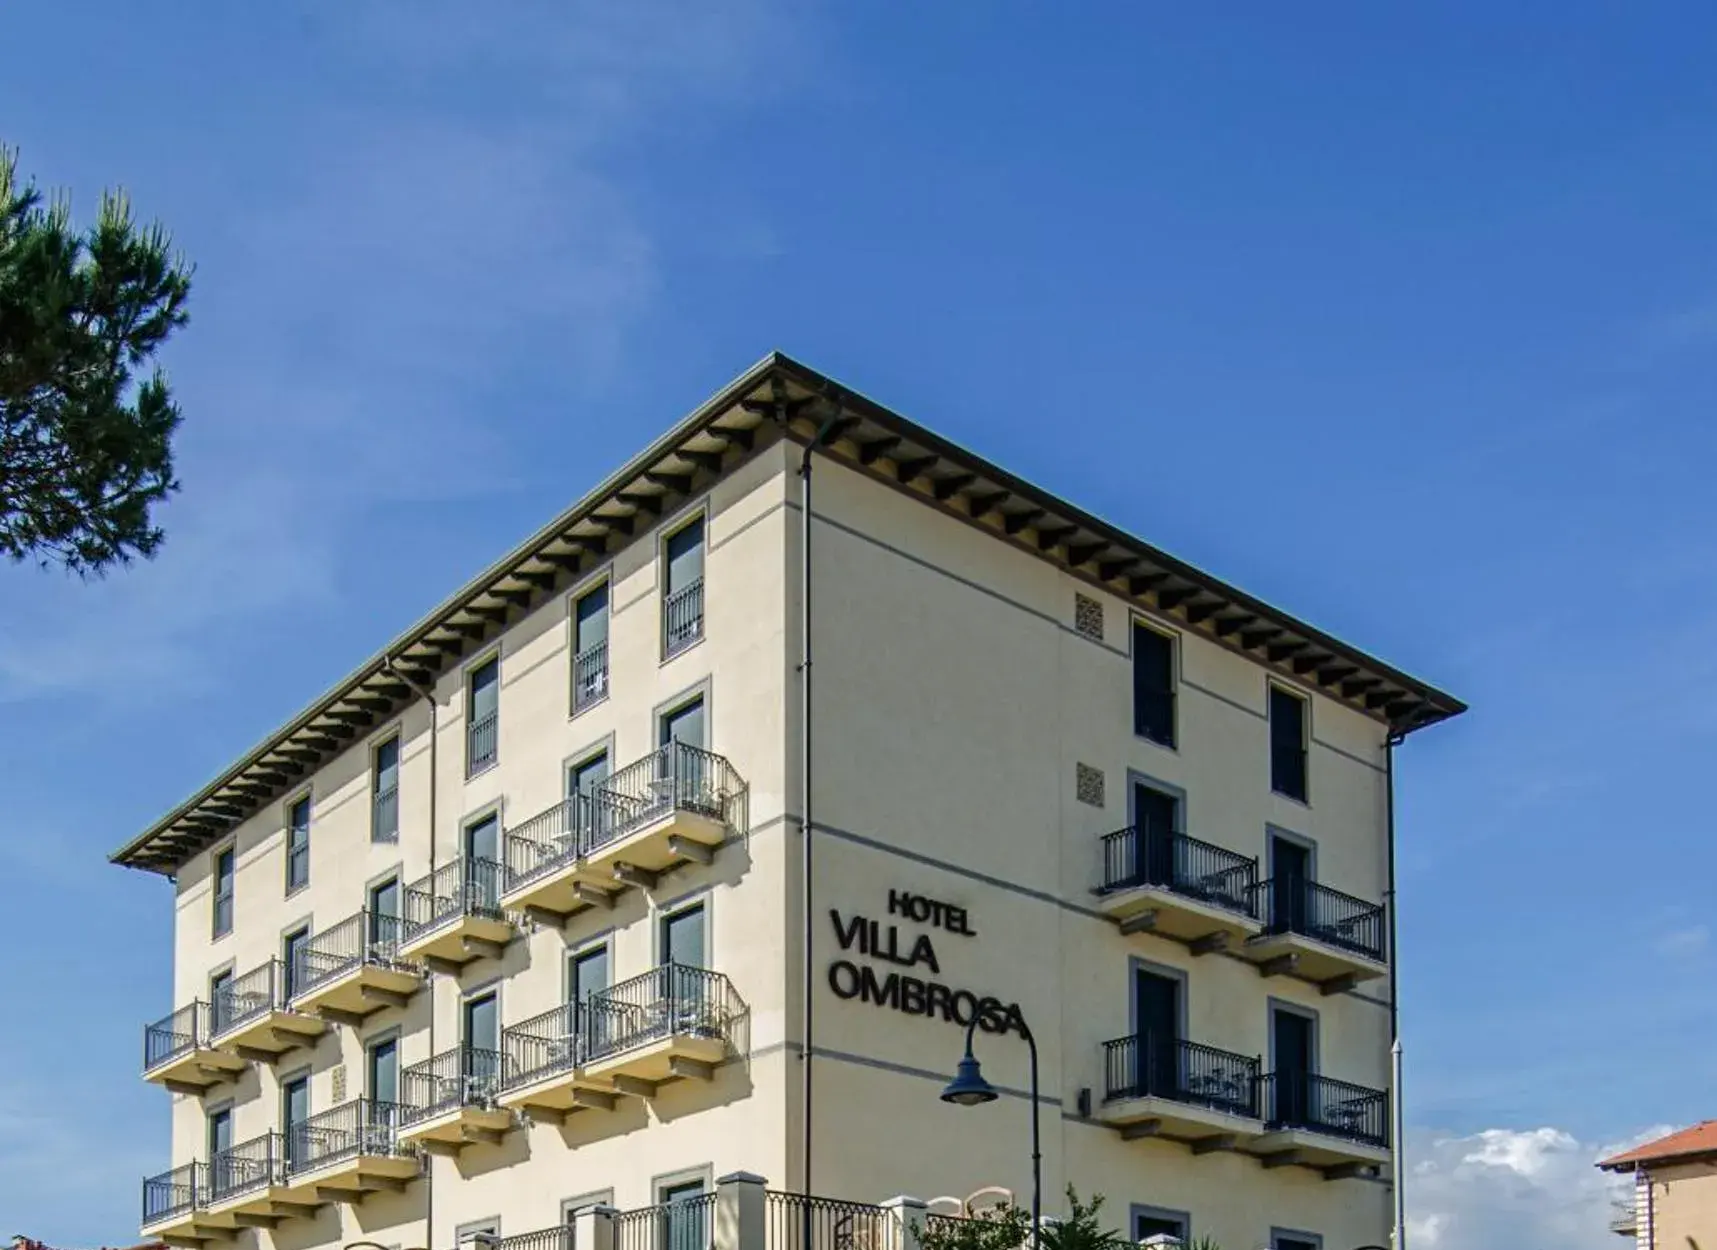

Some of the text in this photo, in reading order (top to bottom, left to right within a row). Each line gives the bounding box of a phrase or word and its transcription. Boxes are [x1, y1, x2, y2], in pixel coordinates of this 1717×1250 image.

[829, 909, 940, 974] VILLA
[888, 889, 977, 937] HOTEL
[828, 960, 1030, 1040] OMBROSA
